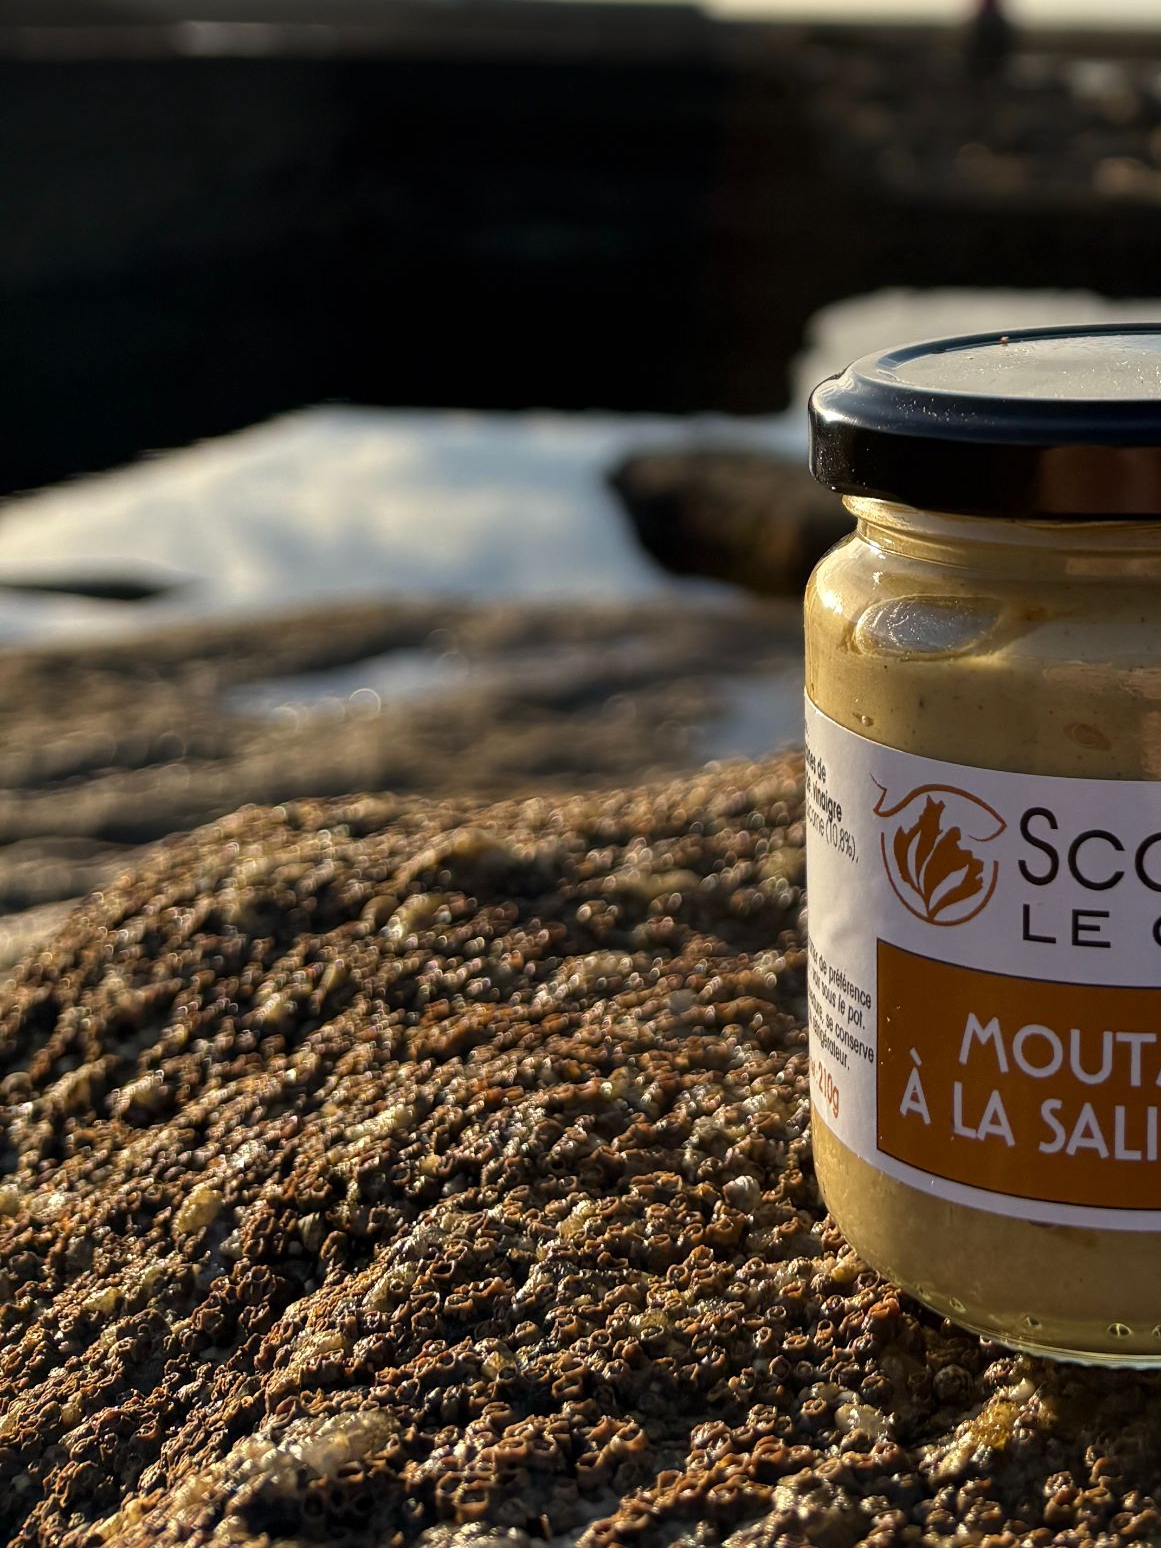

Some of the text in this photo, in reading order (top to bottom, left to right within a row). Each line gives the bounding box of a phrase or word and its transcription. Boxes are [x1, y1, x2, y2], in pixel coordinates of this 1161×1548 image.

[813, 780, 843, 823] vinaigre
[1022, 903, 1112, 949] LE
[821, 979, 837, 1012] sous
[838, 993, 845, 1016] le
[848, 1004, 865, 1030] pot.
[829, 964, 872, 1010] préférence
[826, 1013, 834, 1031] se
[834, 1021, 874, 1064] conserve
[819, 1061, 839, 1119] 210g
[900, 1047, 931, 1125] À
[953, 1081, 1016, 1147] LA
